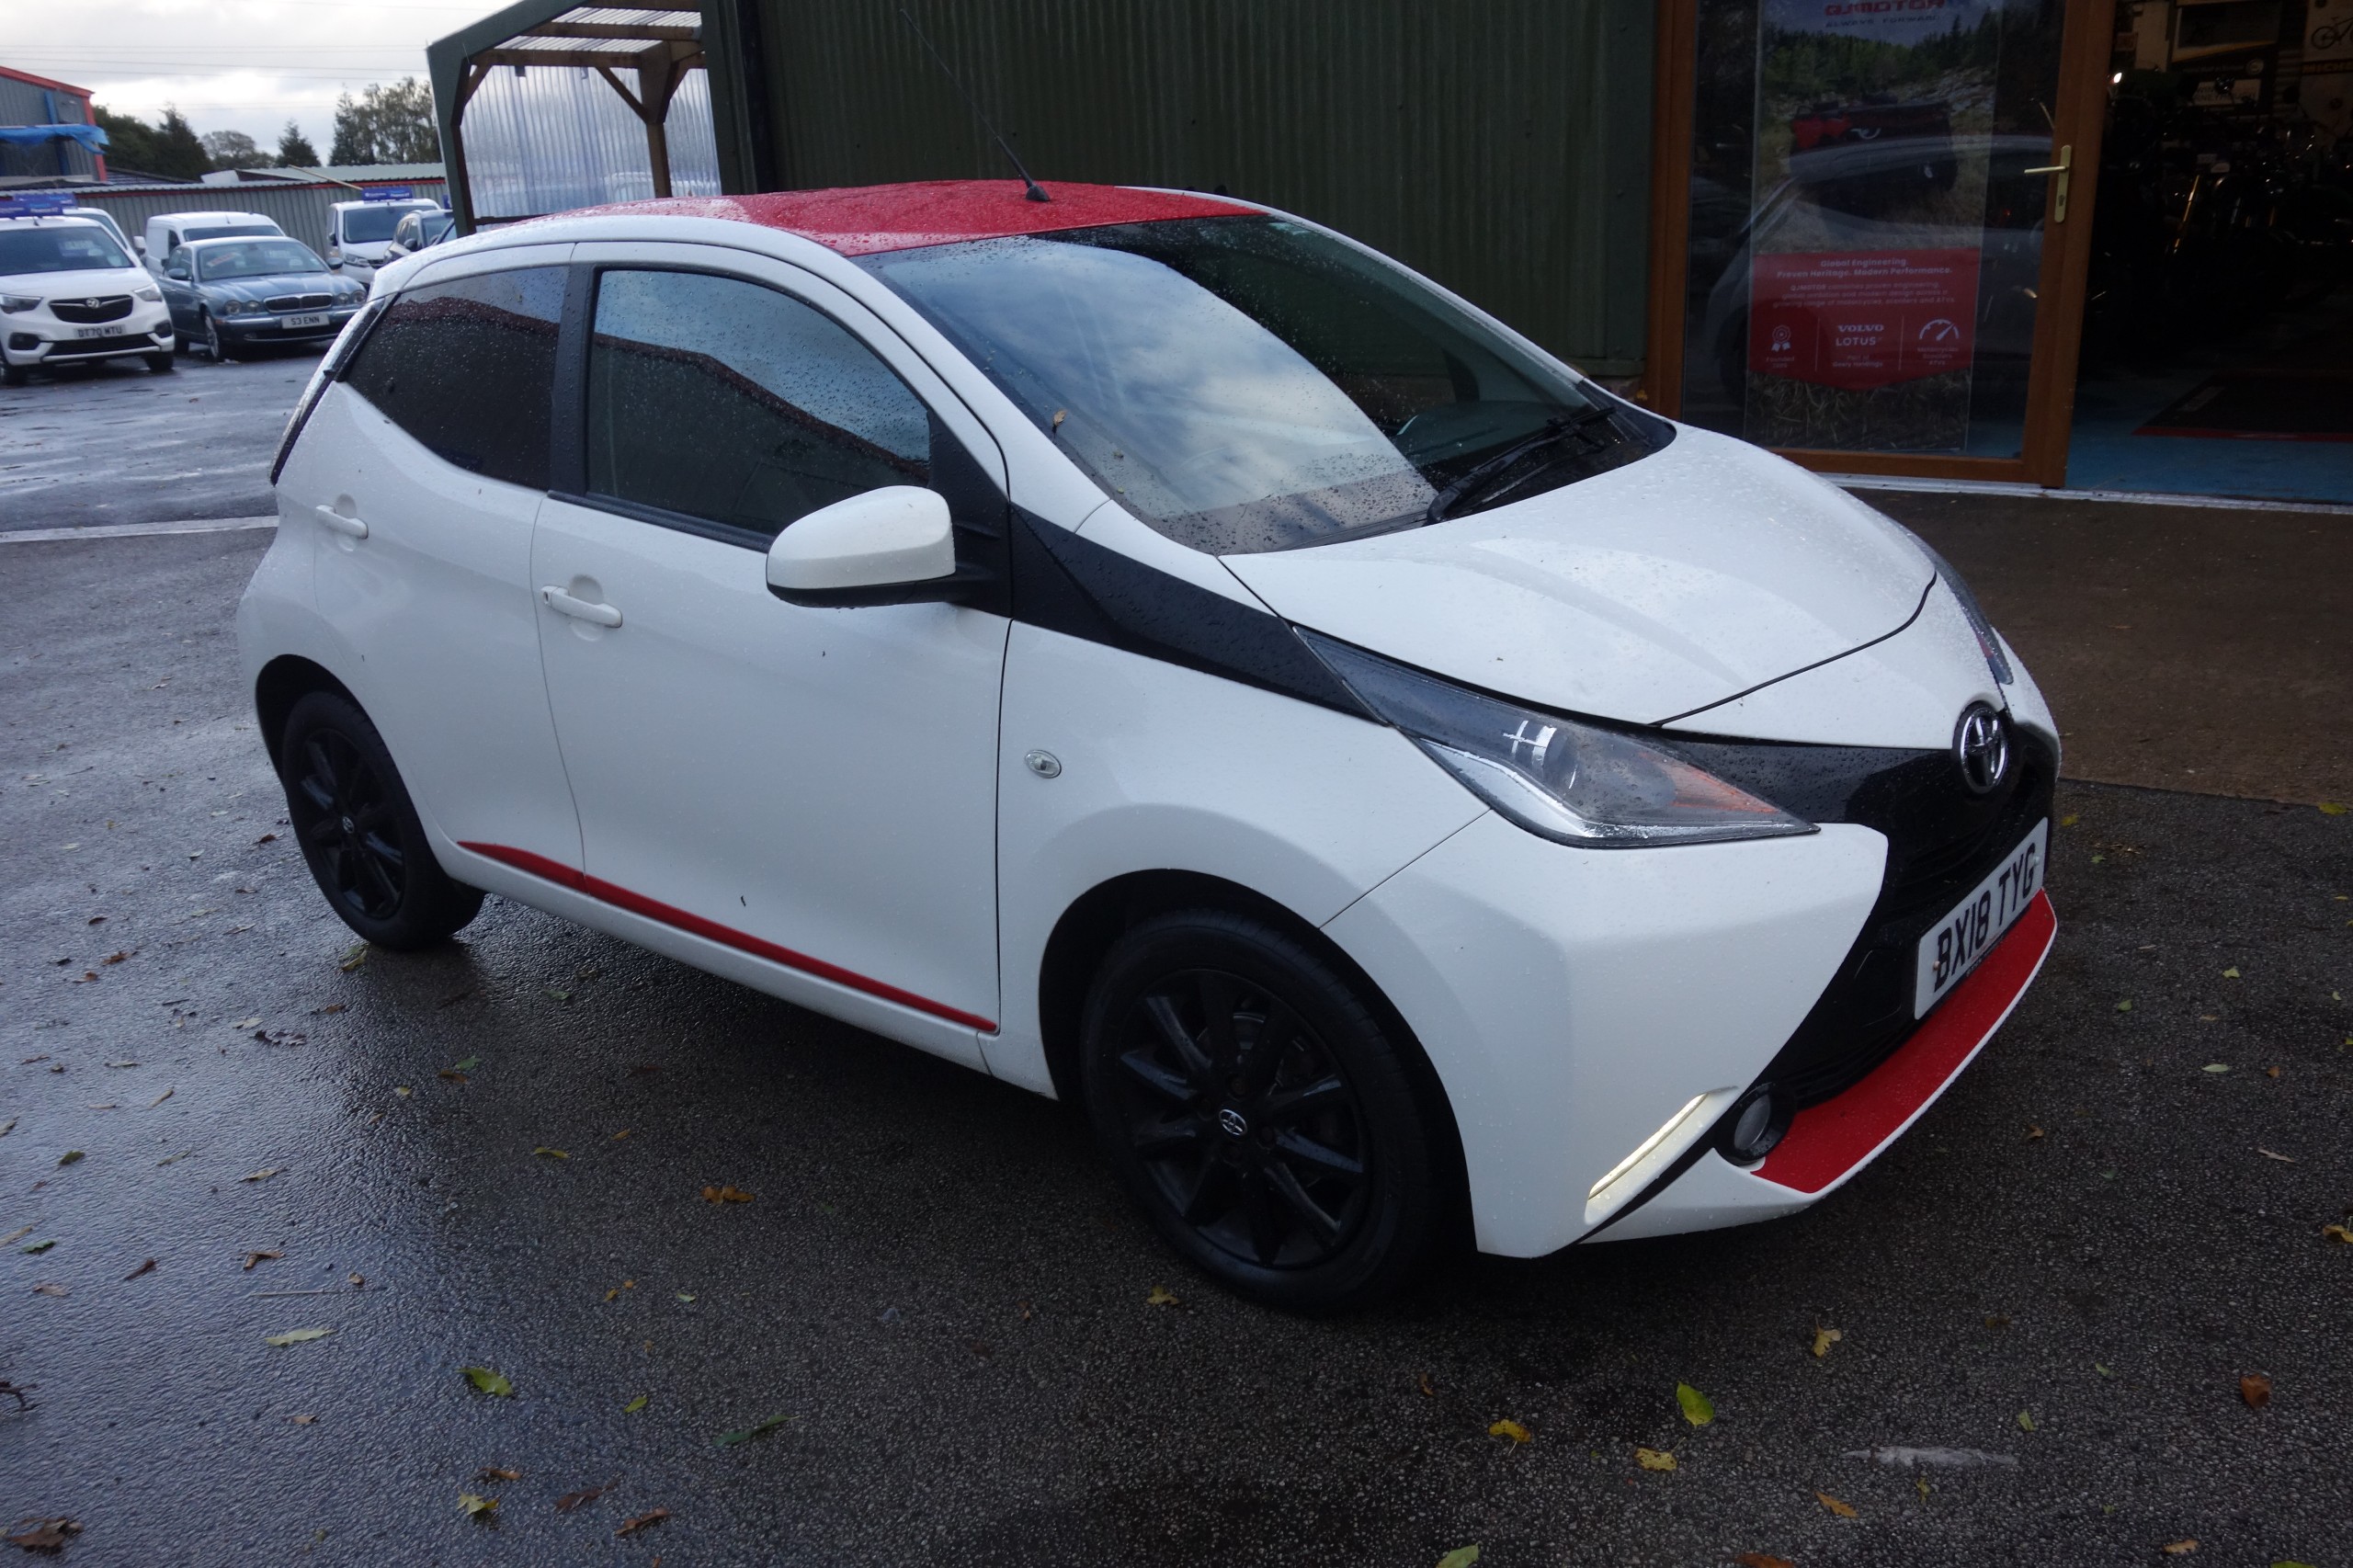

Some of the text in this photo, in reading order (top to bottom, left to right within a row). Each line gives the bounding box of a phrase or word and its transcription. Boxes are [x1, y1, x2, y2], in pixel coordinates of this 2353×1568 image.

[1820, 259, 1850, 267] Global
[1777, 266, 1952, 278] Proven Heritage. Modern Performance.
[290, 316, 320, 325] S3 ENN
[1837, 324, 1884, 333] VOLVO
[1836, 336, 1877, 347] LOTUS
[1934, 890, 1991, 993] BX18
[1998, 841, 2036, 926] TYG
